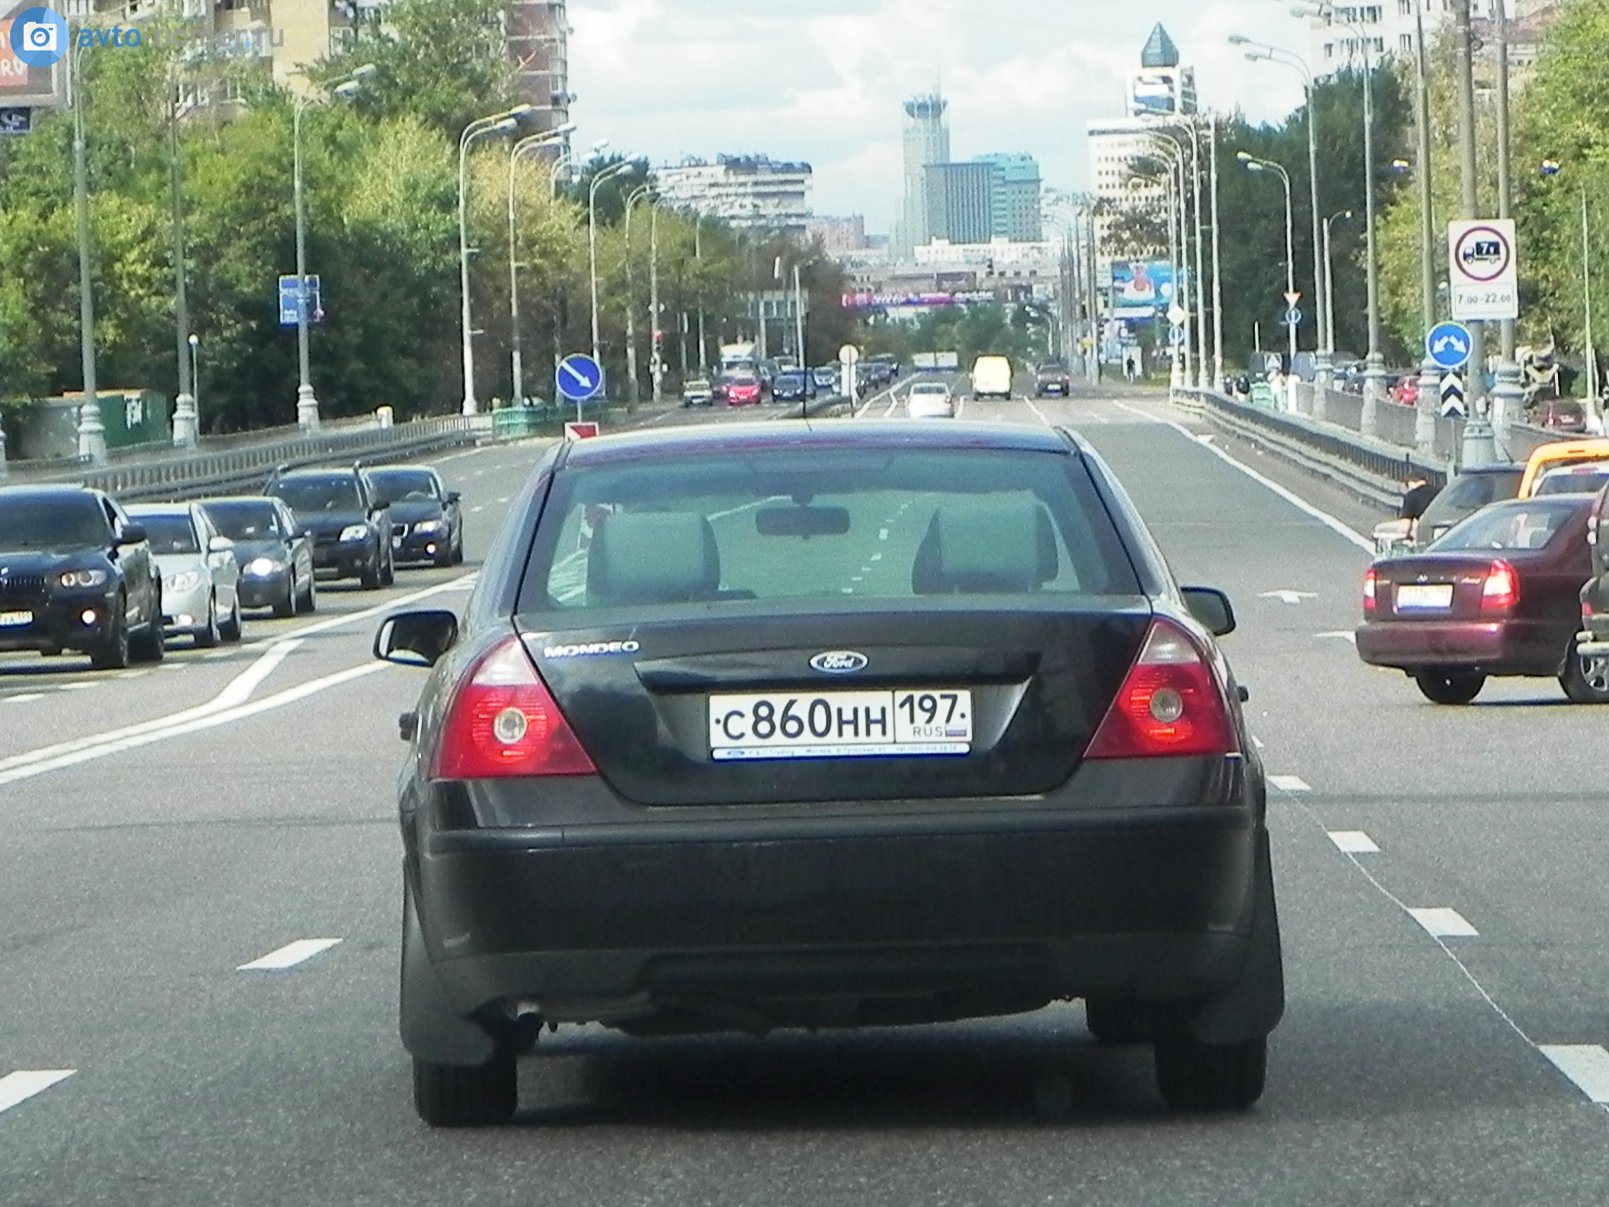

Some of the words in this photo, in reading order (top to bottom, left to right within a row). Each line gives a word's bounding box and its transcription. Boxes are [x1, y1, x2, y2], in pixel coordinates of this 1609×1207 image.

[543, 640, 640, 658] MONDEO
[823, 651, 855, 668] Ford
[898, 693, 958, 725] 197
[913, 726, 943, 737] RUS
